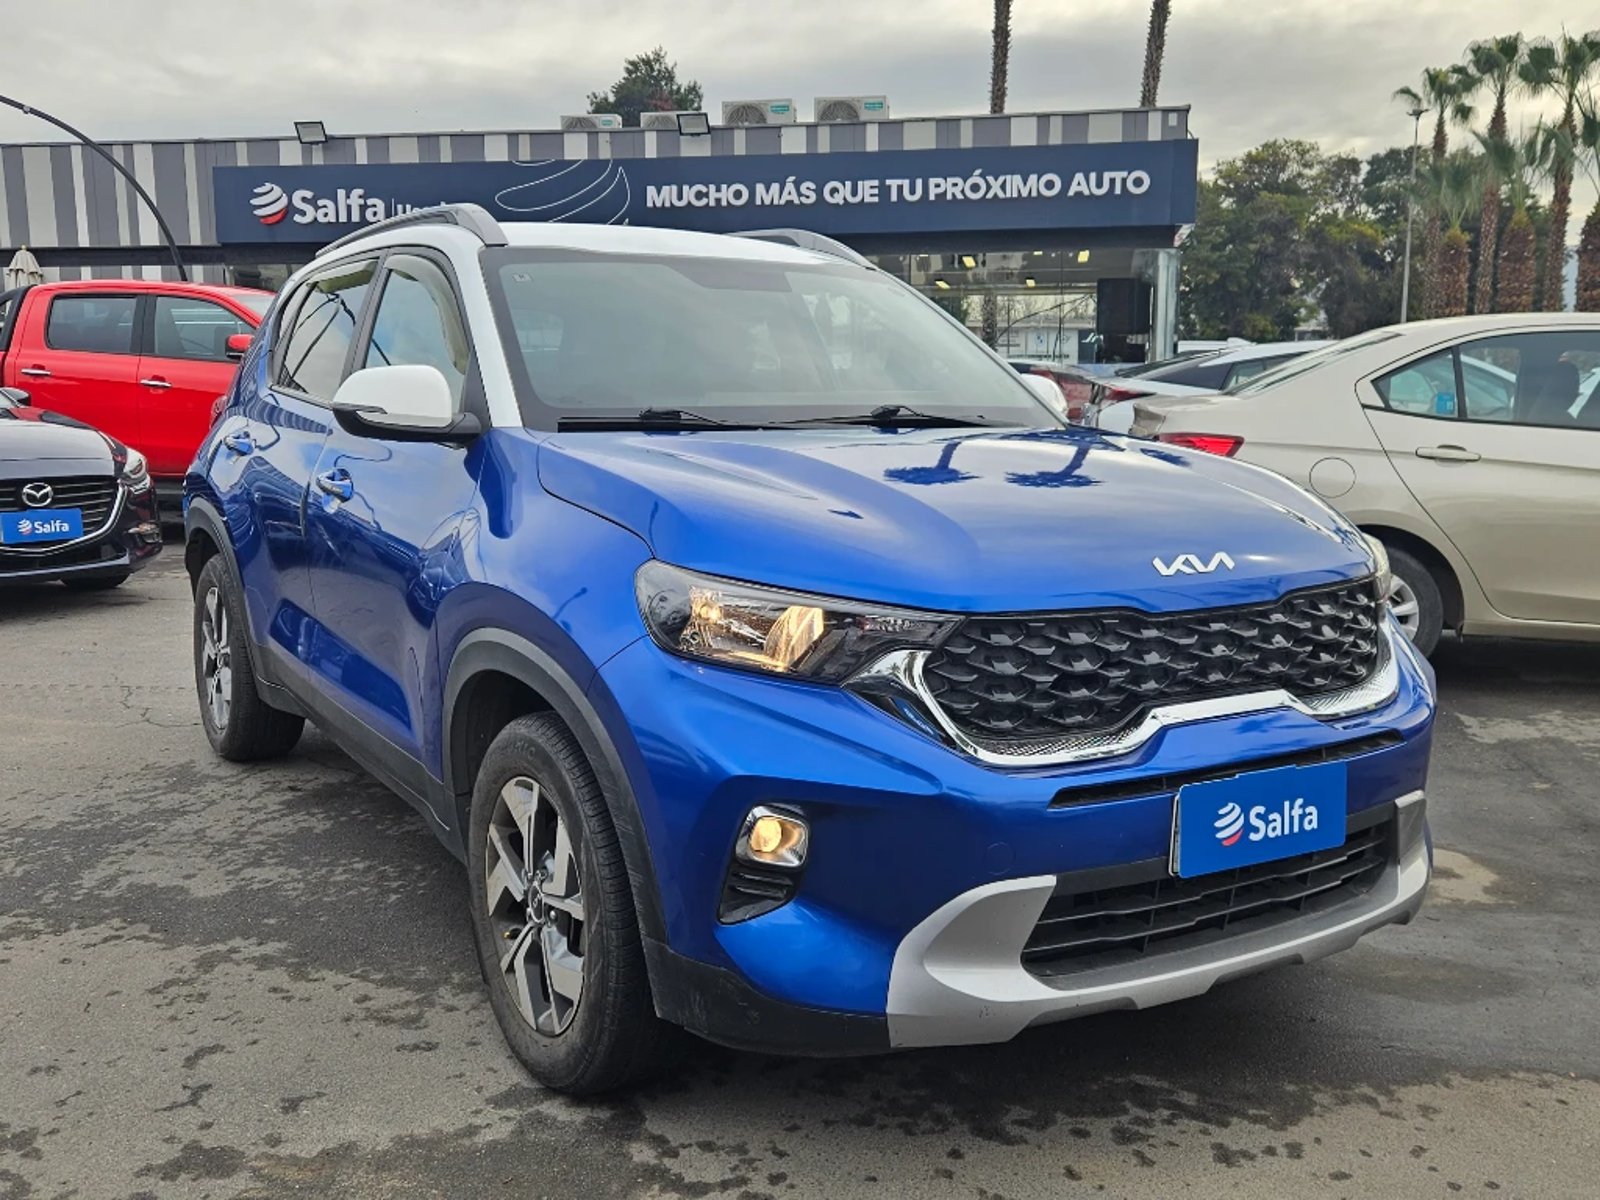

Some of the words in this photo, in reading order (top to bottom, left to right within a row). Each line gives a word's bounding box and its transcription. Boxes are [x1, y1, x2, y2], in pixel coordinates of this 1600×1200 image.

[291, 188, 386, 224] Salfa
[646, 183, 749, 208] MUCHO
[755, 175, 817, 206] MÁS
[822, 179, 880, 206] QUE
[885, 178, 923, 202] TU
[928, 168, 1062, 201] PRÓXIMO
[1067, 170, 1151, 197] AUTO
[33, 519, 70, 534] Salfa
[1248, 798, 1319, 842] Salfa
